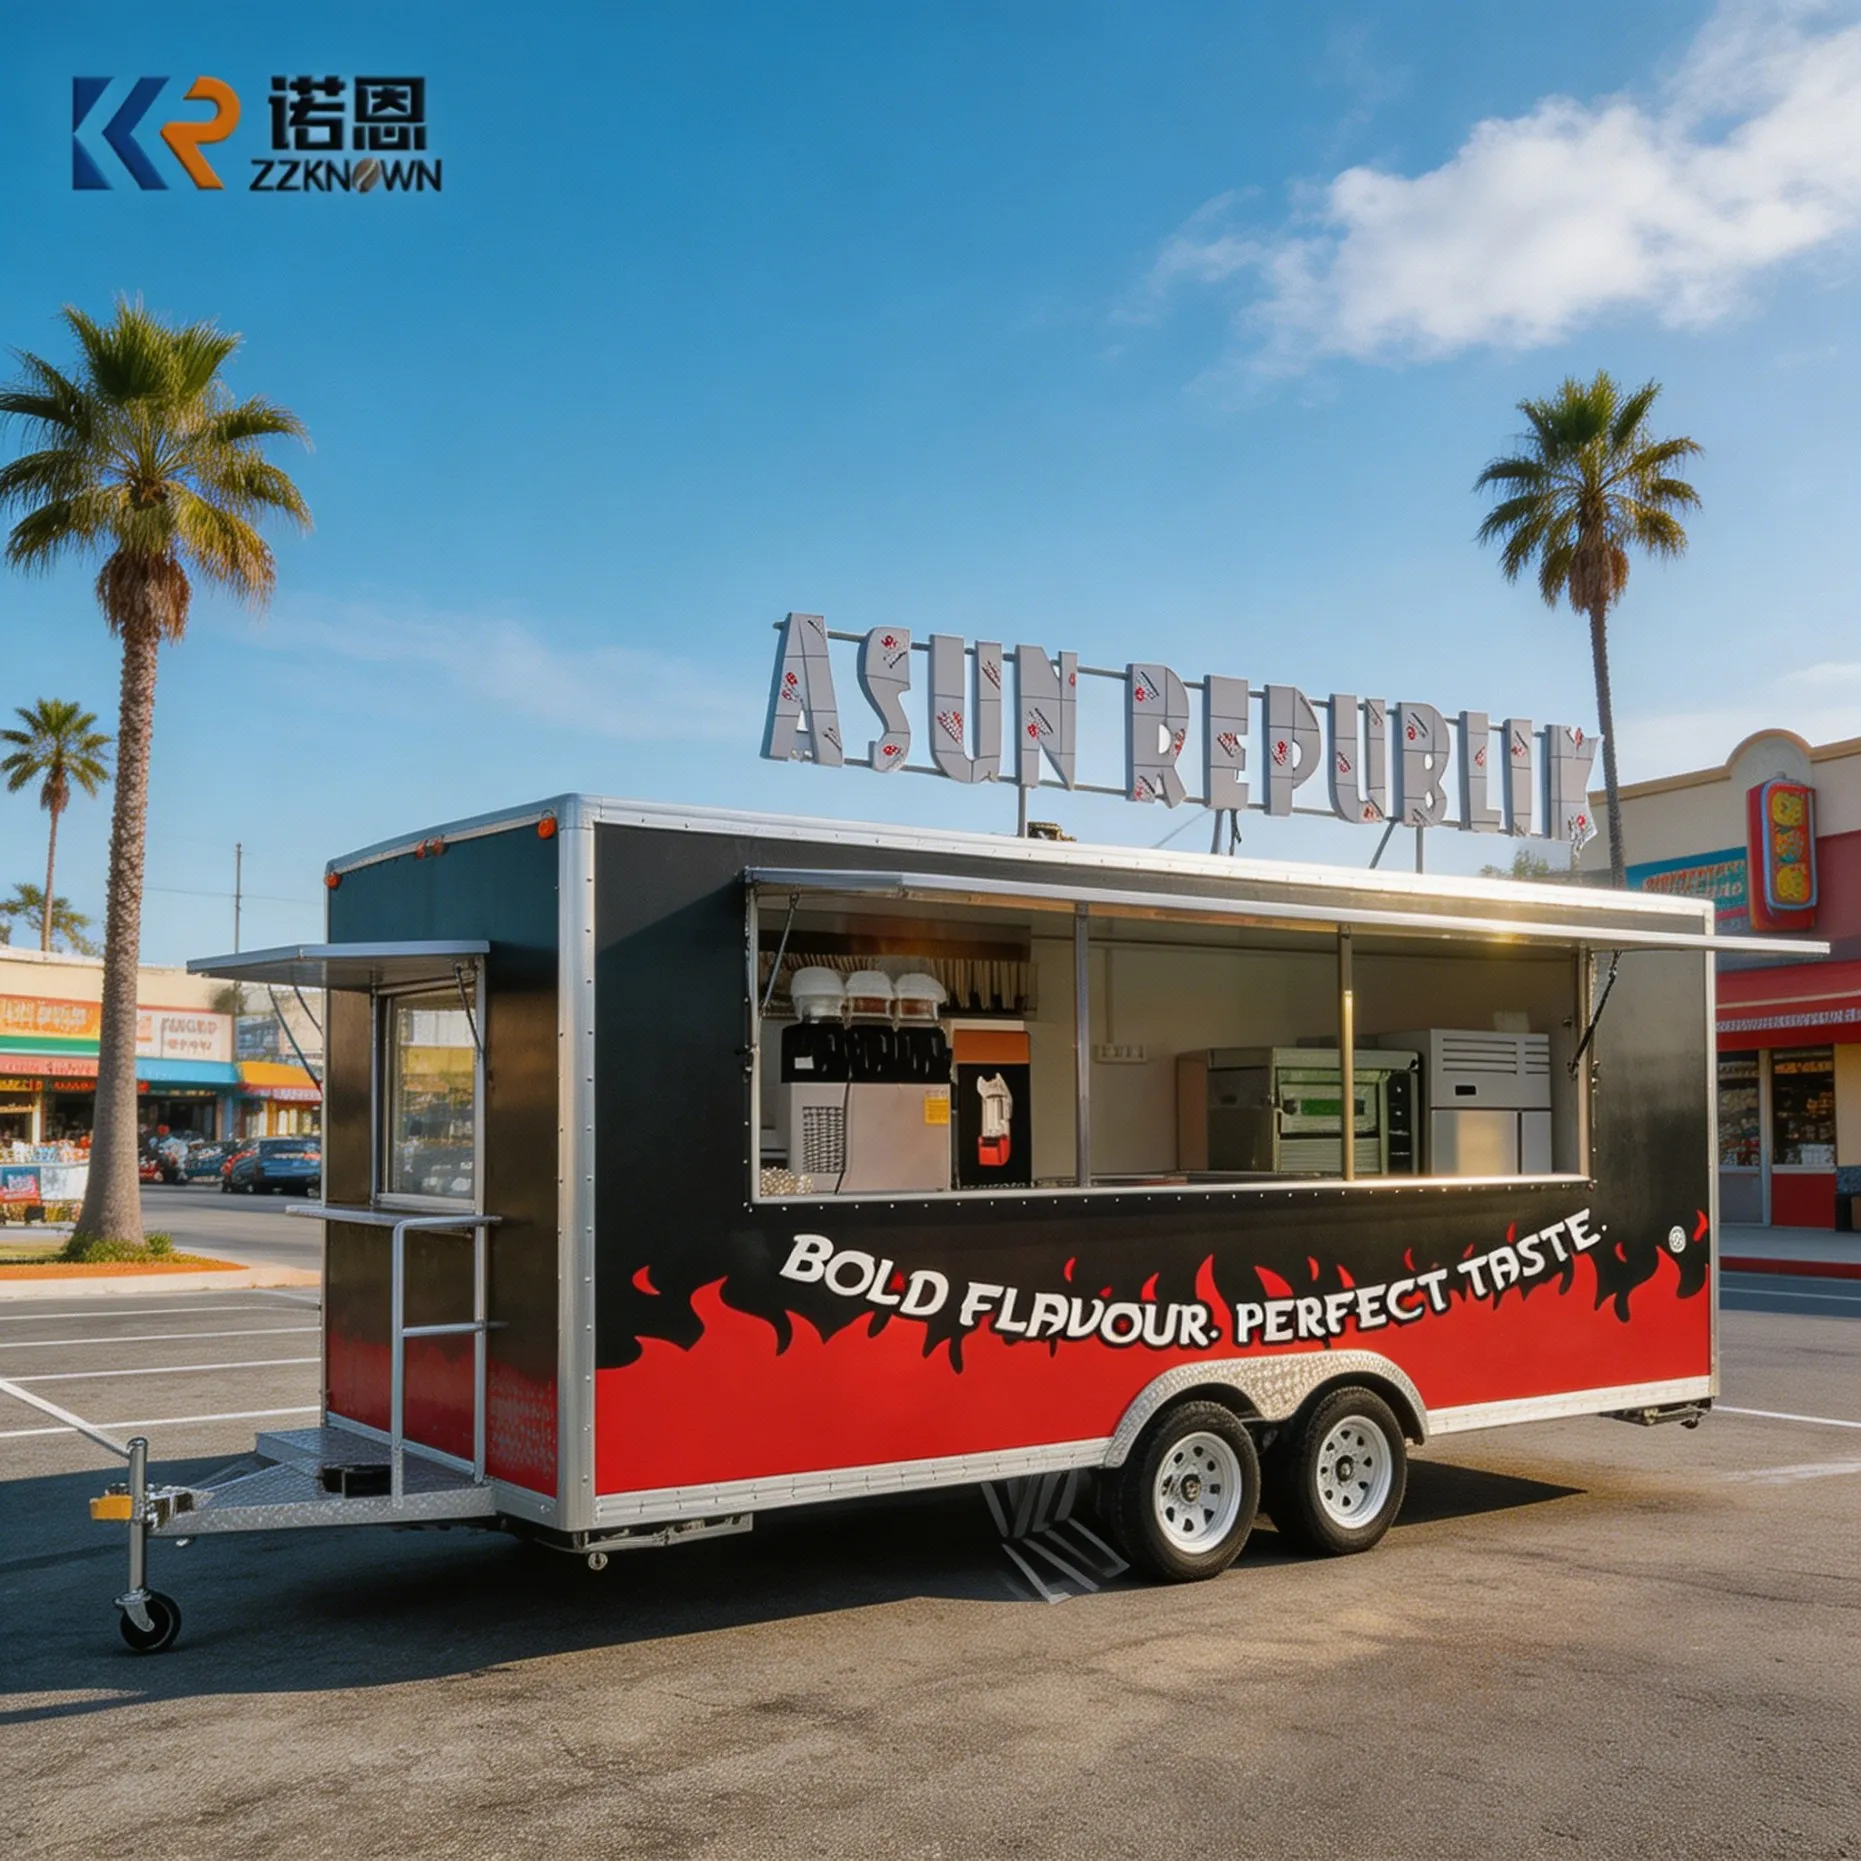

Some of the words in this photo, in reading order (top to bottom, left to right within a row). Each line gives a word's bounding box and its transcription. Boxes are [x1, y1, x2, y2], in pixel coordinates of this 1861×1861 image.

[760, 611, 1078, 791] ASUN
[779, 1233, 949, 1317] BOLD
[959, 1281, 1220, 1347] FLAVOUR.
[1235, 1267, 1448, 1343] PERFECT
[1456, 1208, 1608, 1298] TASTE.
